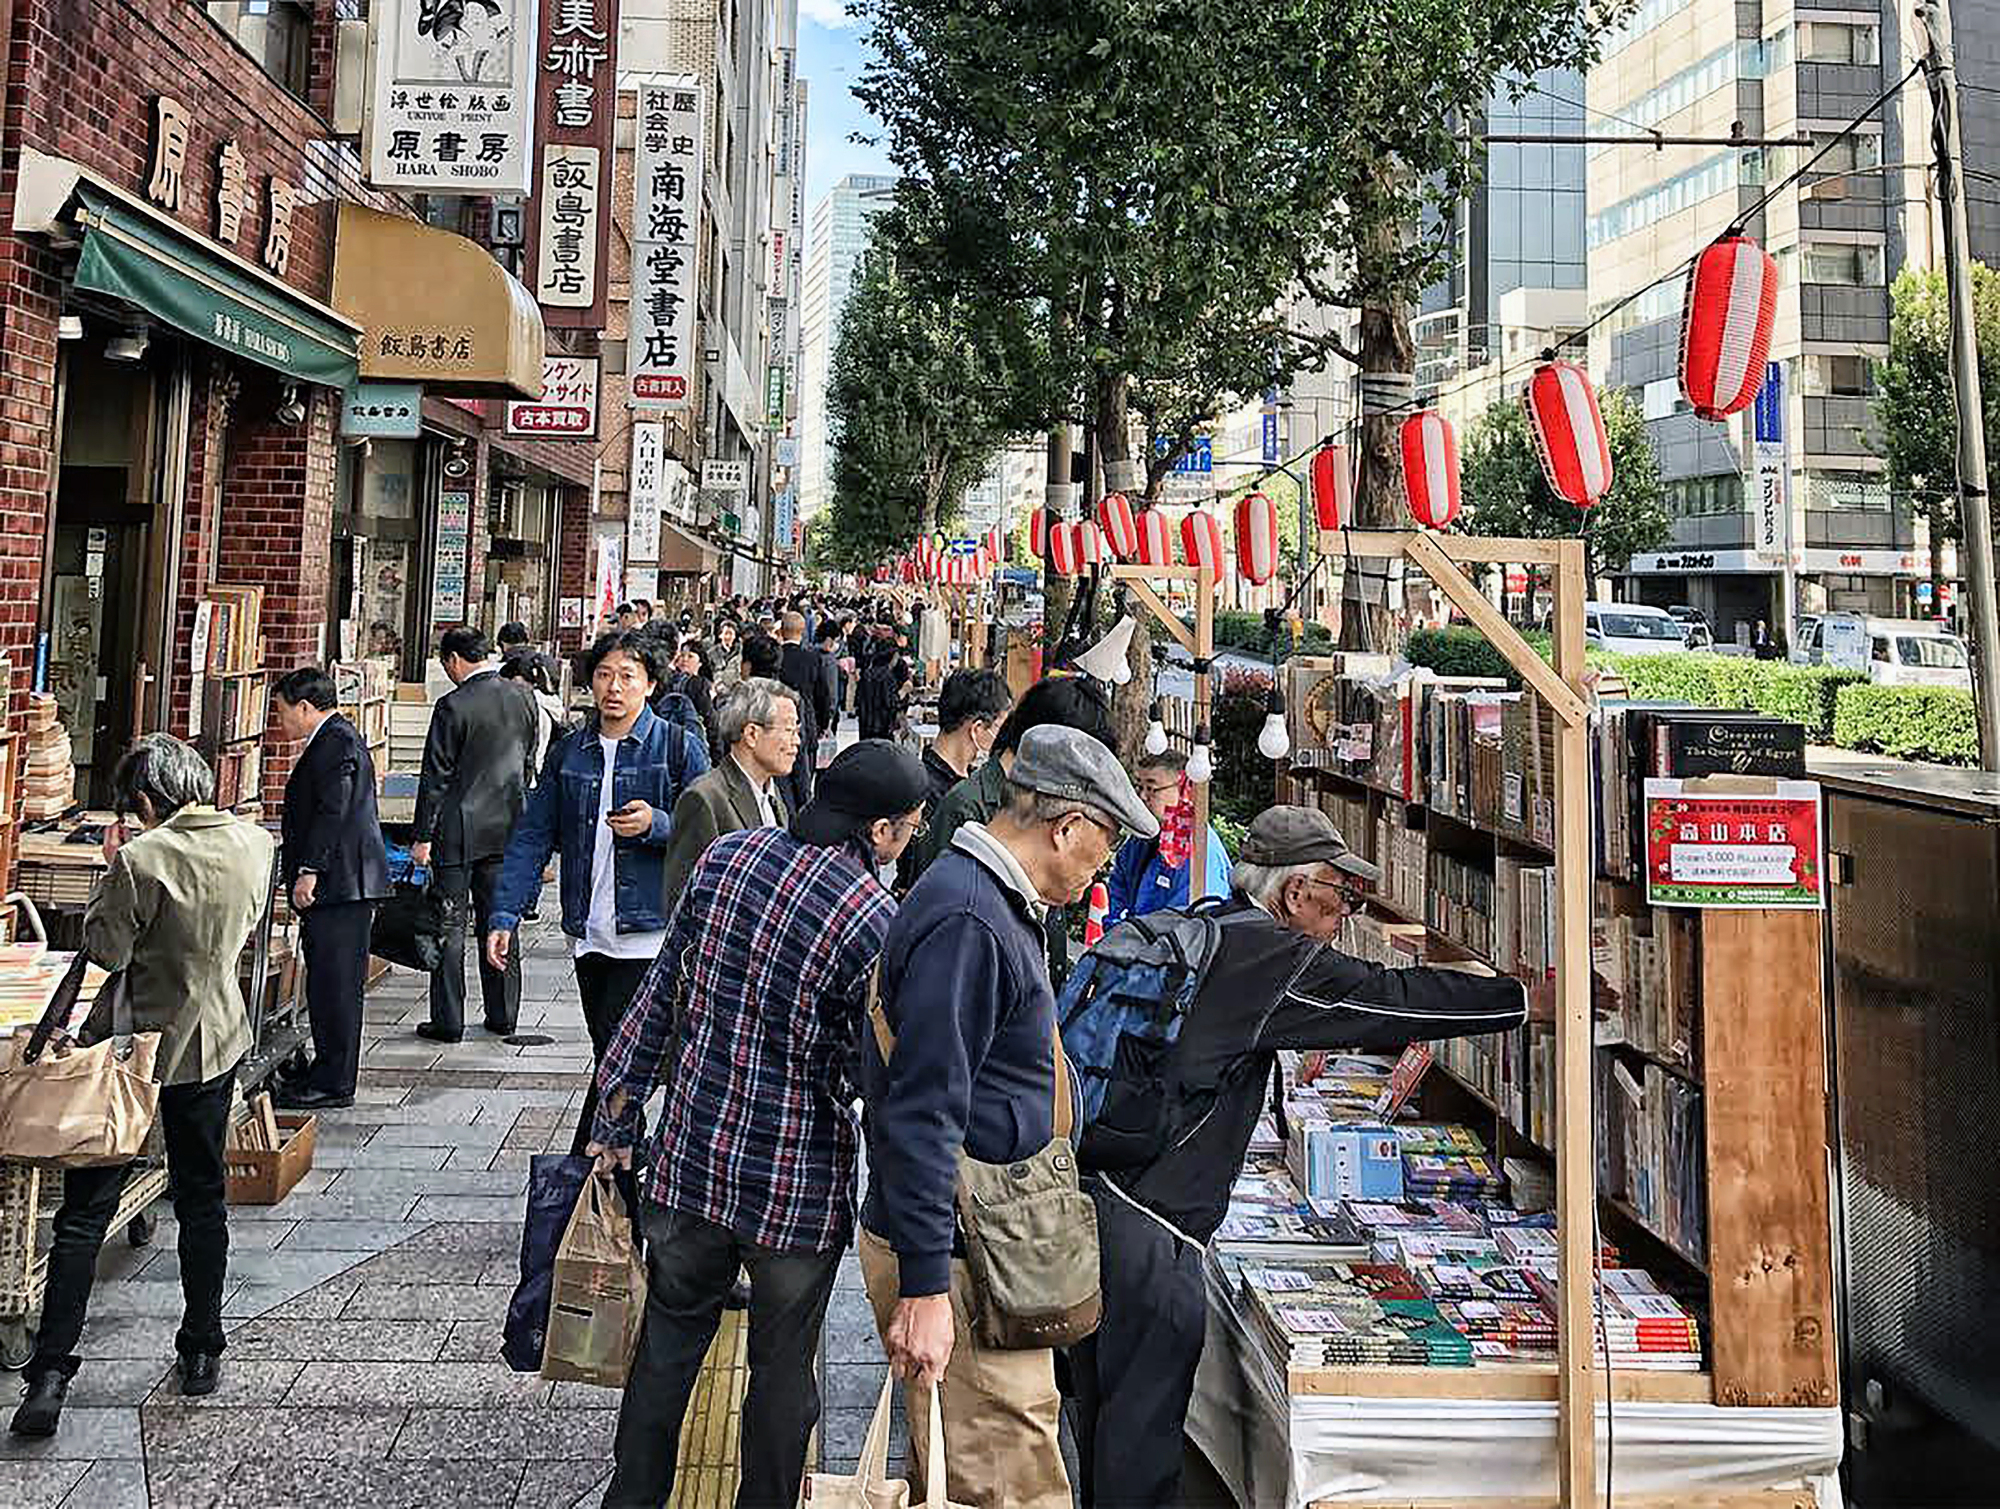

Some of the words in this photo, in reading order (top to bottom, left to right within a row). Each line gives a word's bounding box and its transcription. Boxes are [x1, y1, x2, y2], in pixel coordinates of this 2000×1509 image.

[543, 0, 607, 127] 美術書
[390, 90, 459, 110] 浮世絵
[467, 94, 511, 112] 版画
[645, 90, 671, 154] 社会学
[671, 91, 697, 156] 歴史
[387, 131, 510, 163] 原書房
[396, 163, 438, 176] HARA
[450, 164, 500, 178] SHOBO
[543, 156, 593, 294] 飯島書店
[639, 161, 689, 368] 南海堂書店
[380, 334, 470, 359] 飯島書店
[520, 409, 585, 427] 古本買取
[1706, 851, 1735, 863] 5,000
